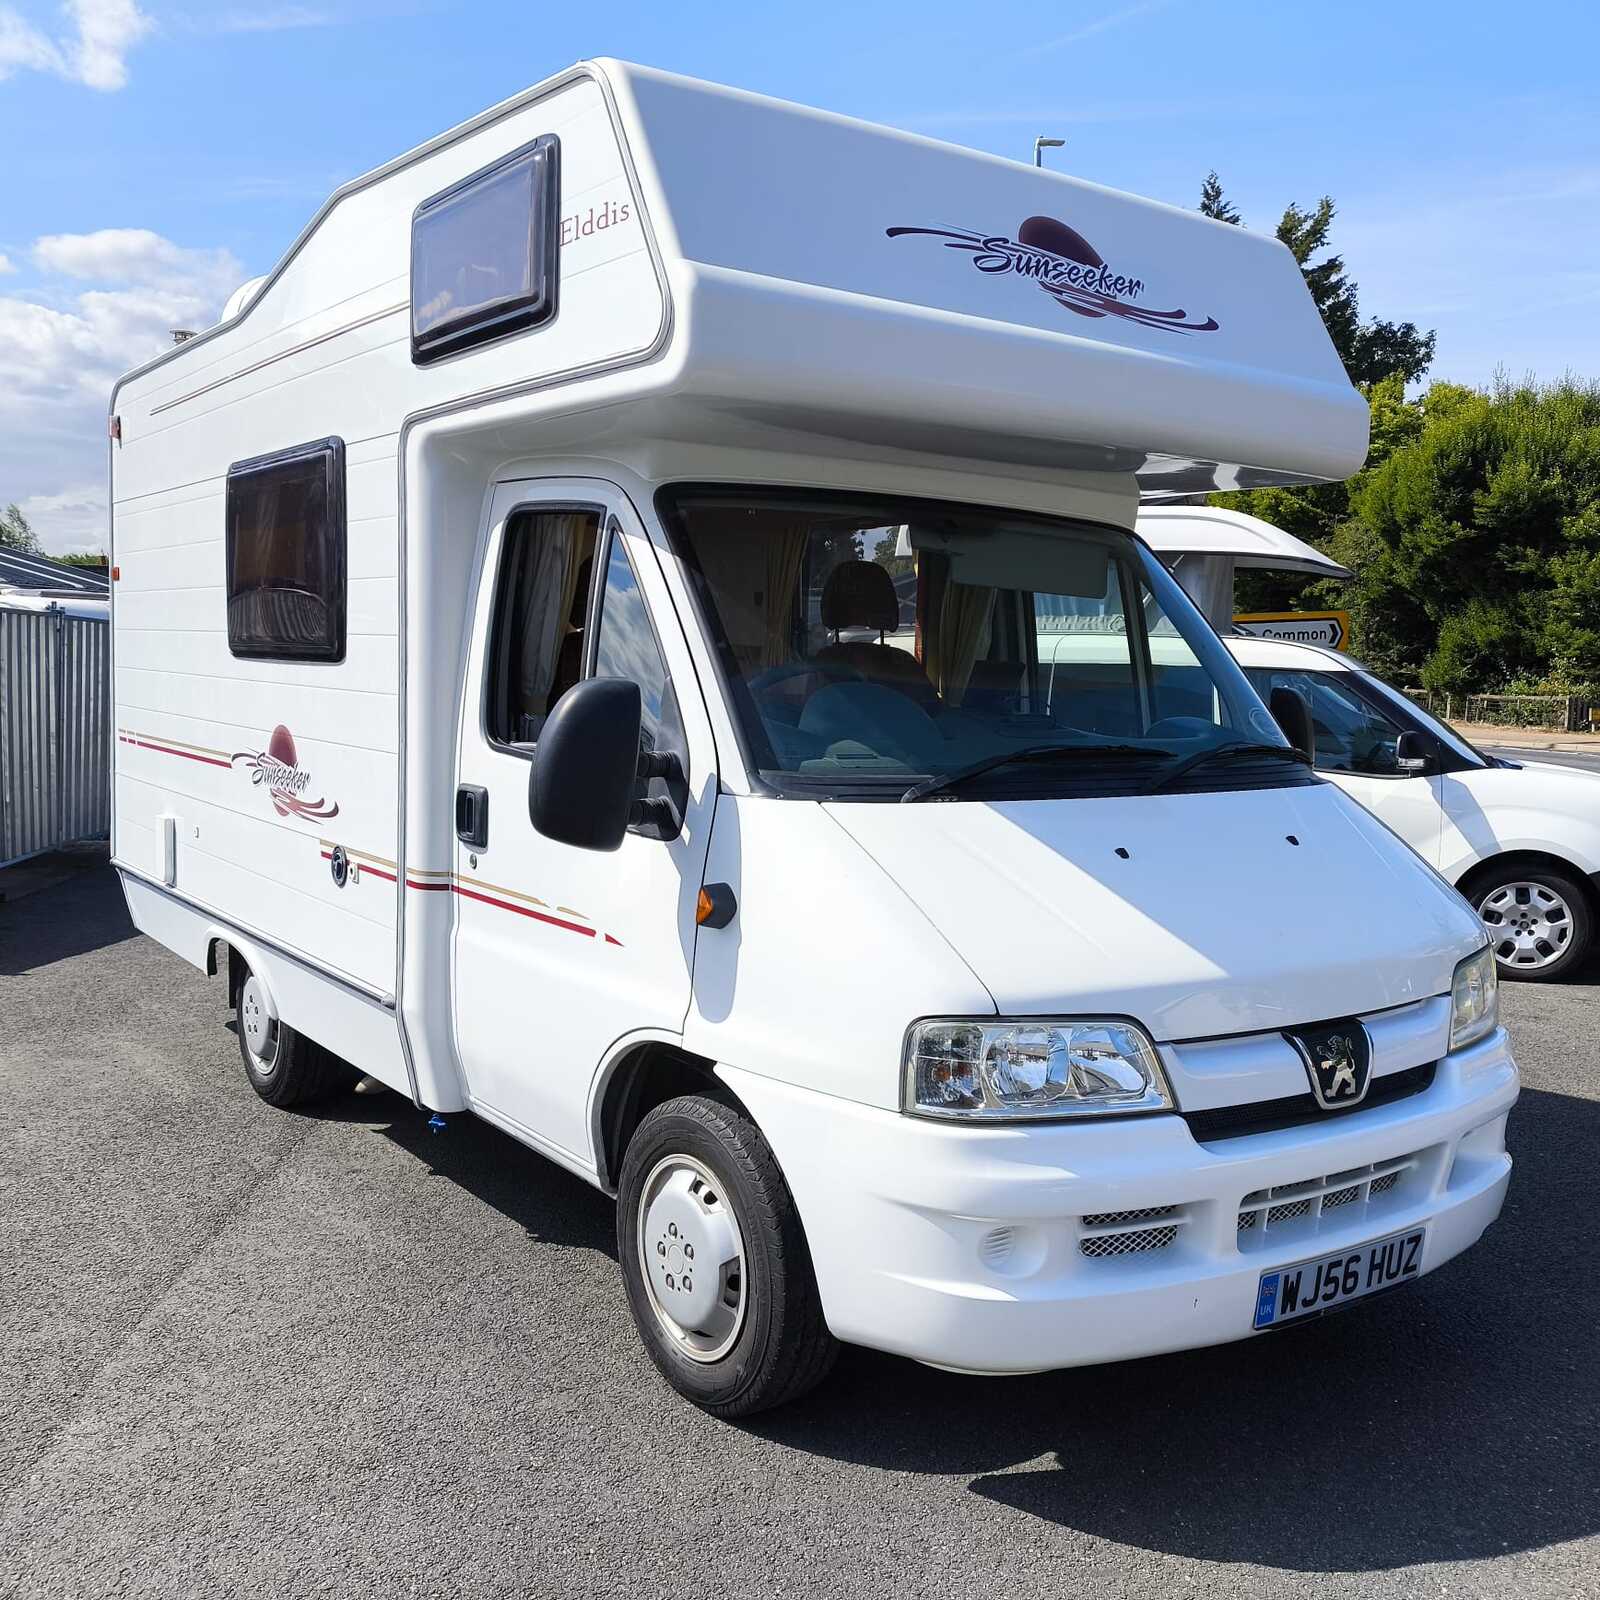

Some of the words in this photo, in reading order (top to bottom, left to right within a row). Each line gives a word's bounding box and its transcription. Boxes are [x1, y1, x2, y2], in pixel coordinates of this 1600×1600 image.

[560, 201, 629, 247] Elddis
[973, 237, 1143, 298] Sunseeker
[251, 752, 311, 793] Sunseeker
[1280, 1254, 1361, 1315] WJ56
[1366, 1233, 1422, 1289] HUZ
[1260, 1304, 1273, 1316] UK
